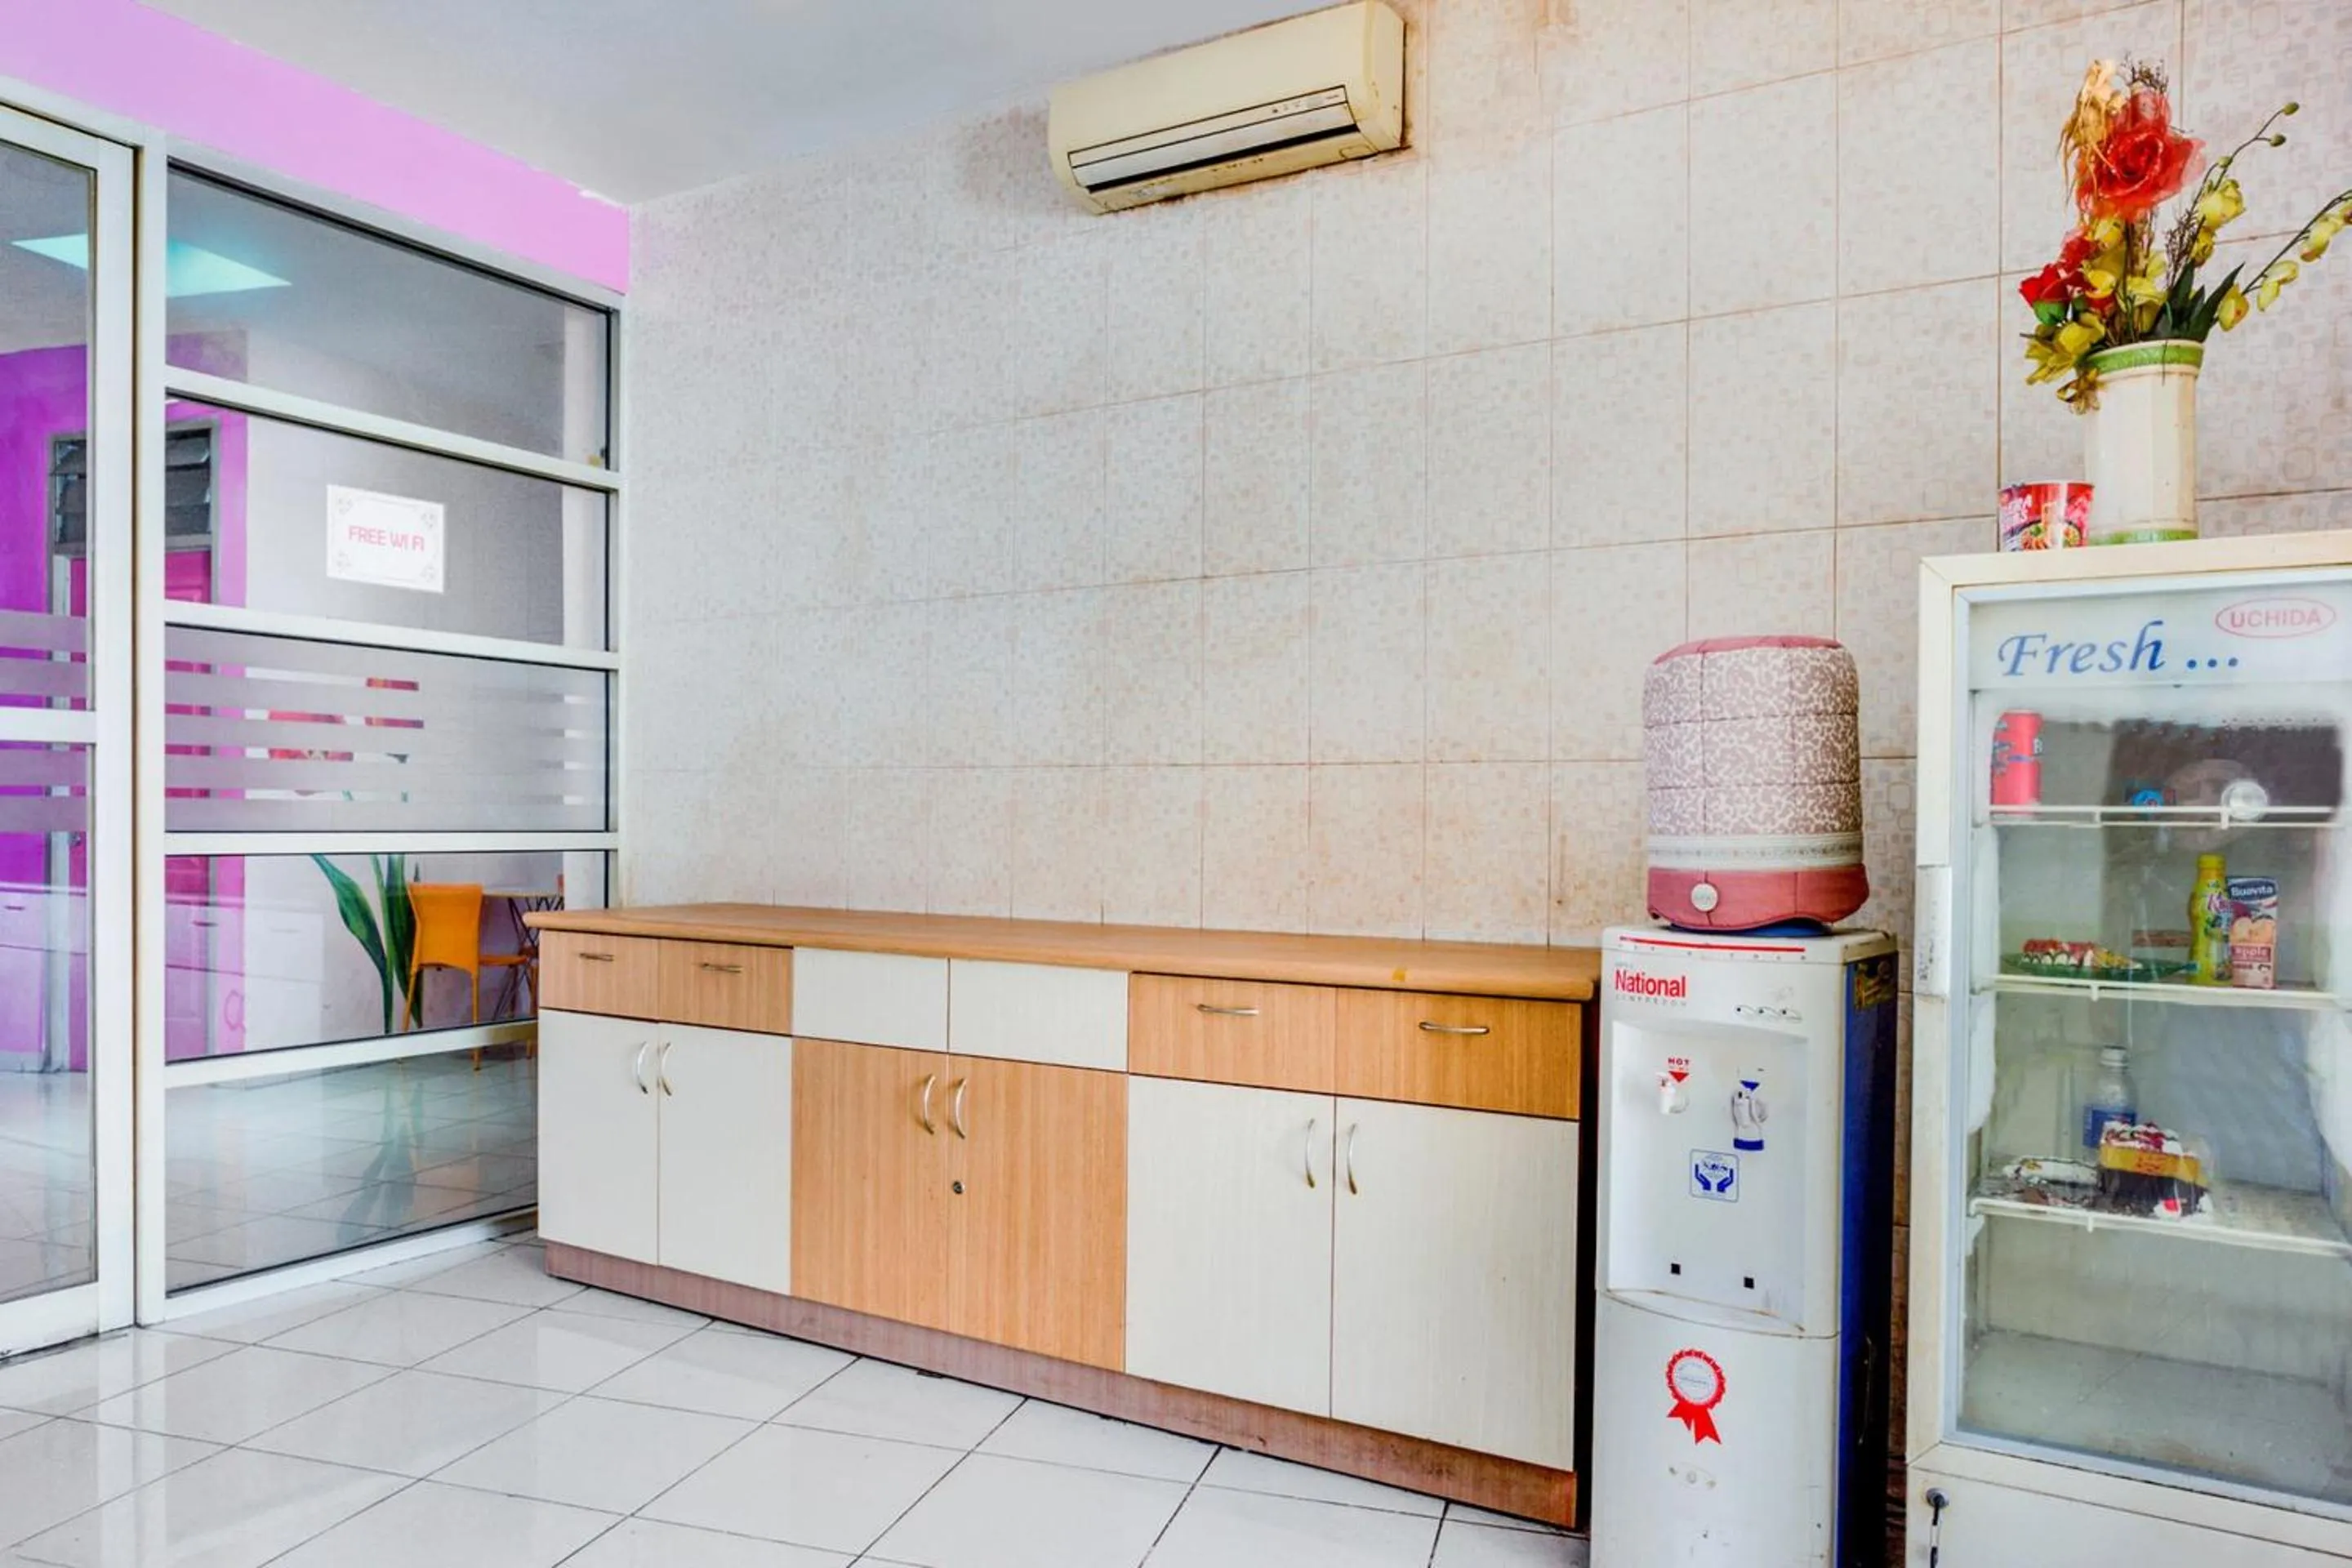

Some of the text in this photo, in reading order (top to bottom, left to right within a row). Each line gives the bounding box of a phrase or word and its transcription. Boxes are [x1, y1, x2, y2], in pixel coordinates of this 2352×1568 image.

[348, 525, 386, 546] FREE
[2230, 608, 2322, 629] UCHIDA
[1615, 969, 1686, 998] National
[1668, 1057, 1690, 1066] HOT
